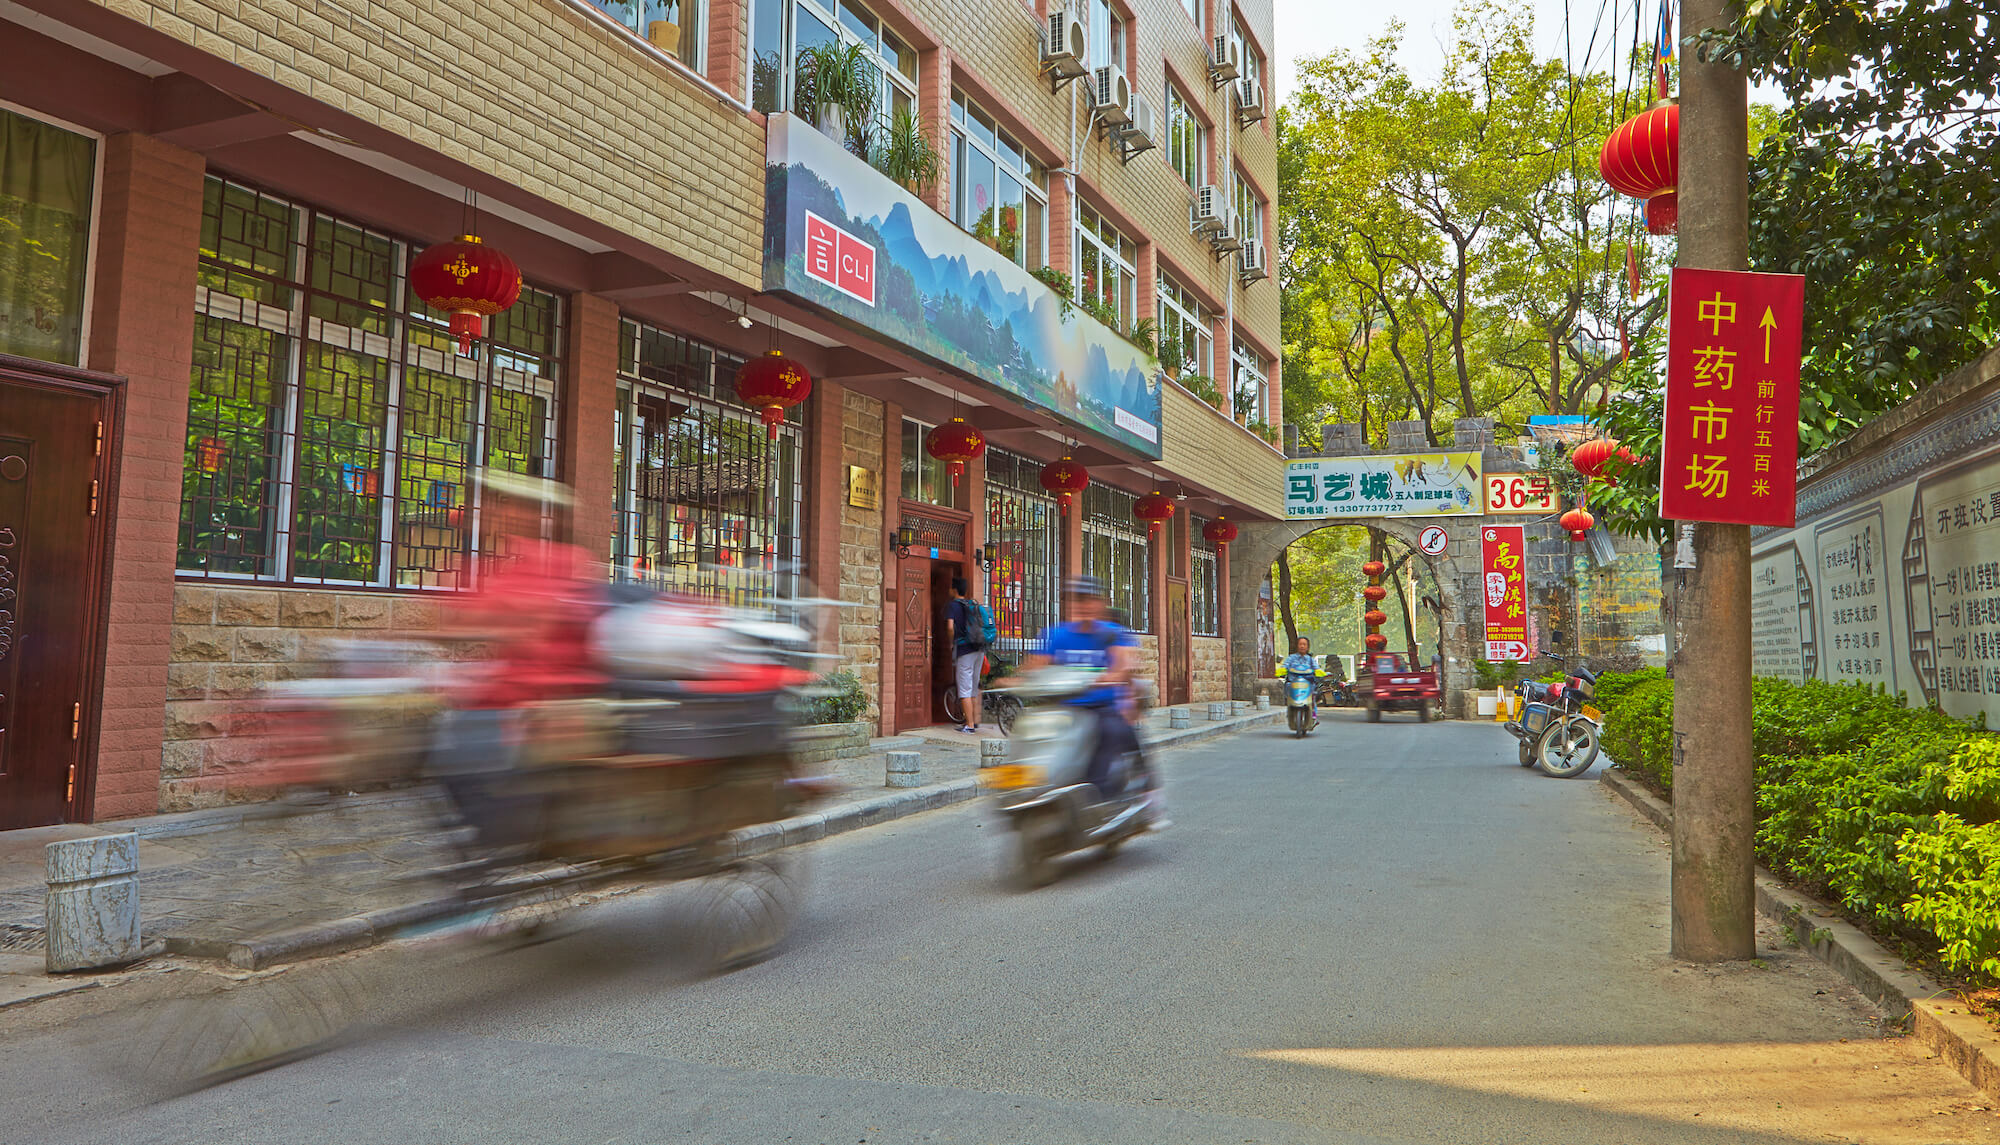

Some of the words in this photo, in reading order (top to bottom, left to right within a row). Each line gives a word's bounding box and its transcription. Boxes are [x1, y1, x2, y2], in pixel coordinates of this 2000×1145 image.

[811, 228, 833, 273] 言
[842, 253, 869, 283] CLI
[1683, 290, 1738, 499] 中药市场
[1751, 379, 1777, 498] 前行五百米
[1287, 471, 1393, 504] 马艺城
[1395, 490, 1453, 501] 五人制足球场
[1490, 477, 1554, 509] 36号
[1333, 504, 1404, 513] 13307737727
[1936, 491, 2000, 535] 开班设置
[1493, 541, 1525, 619] 高山流水
